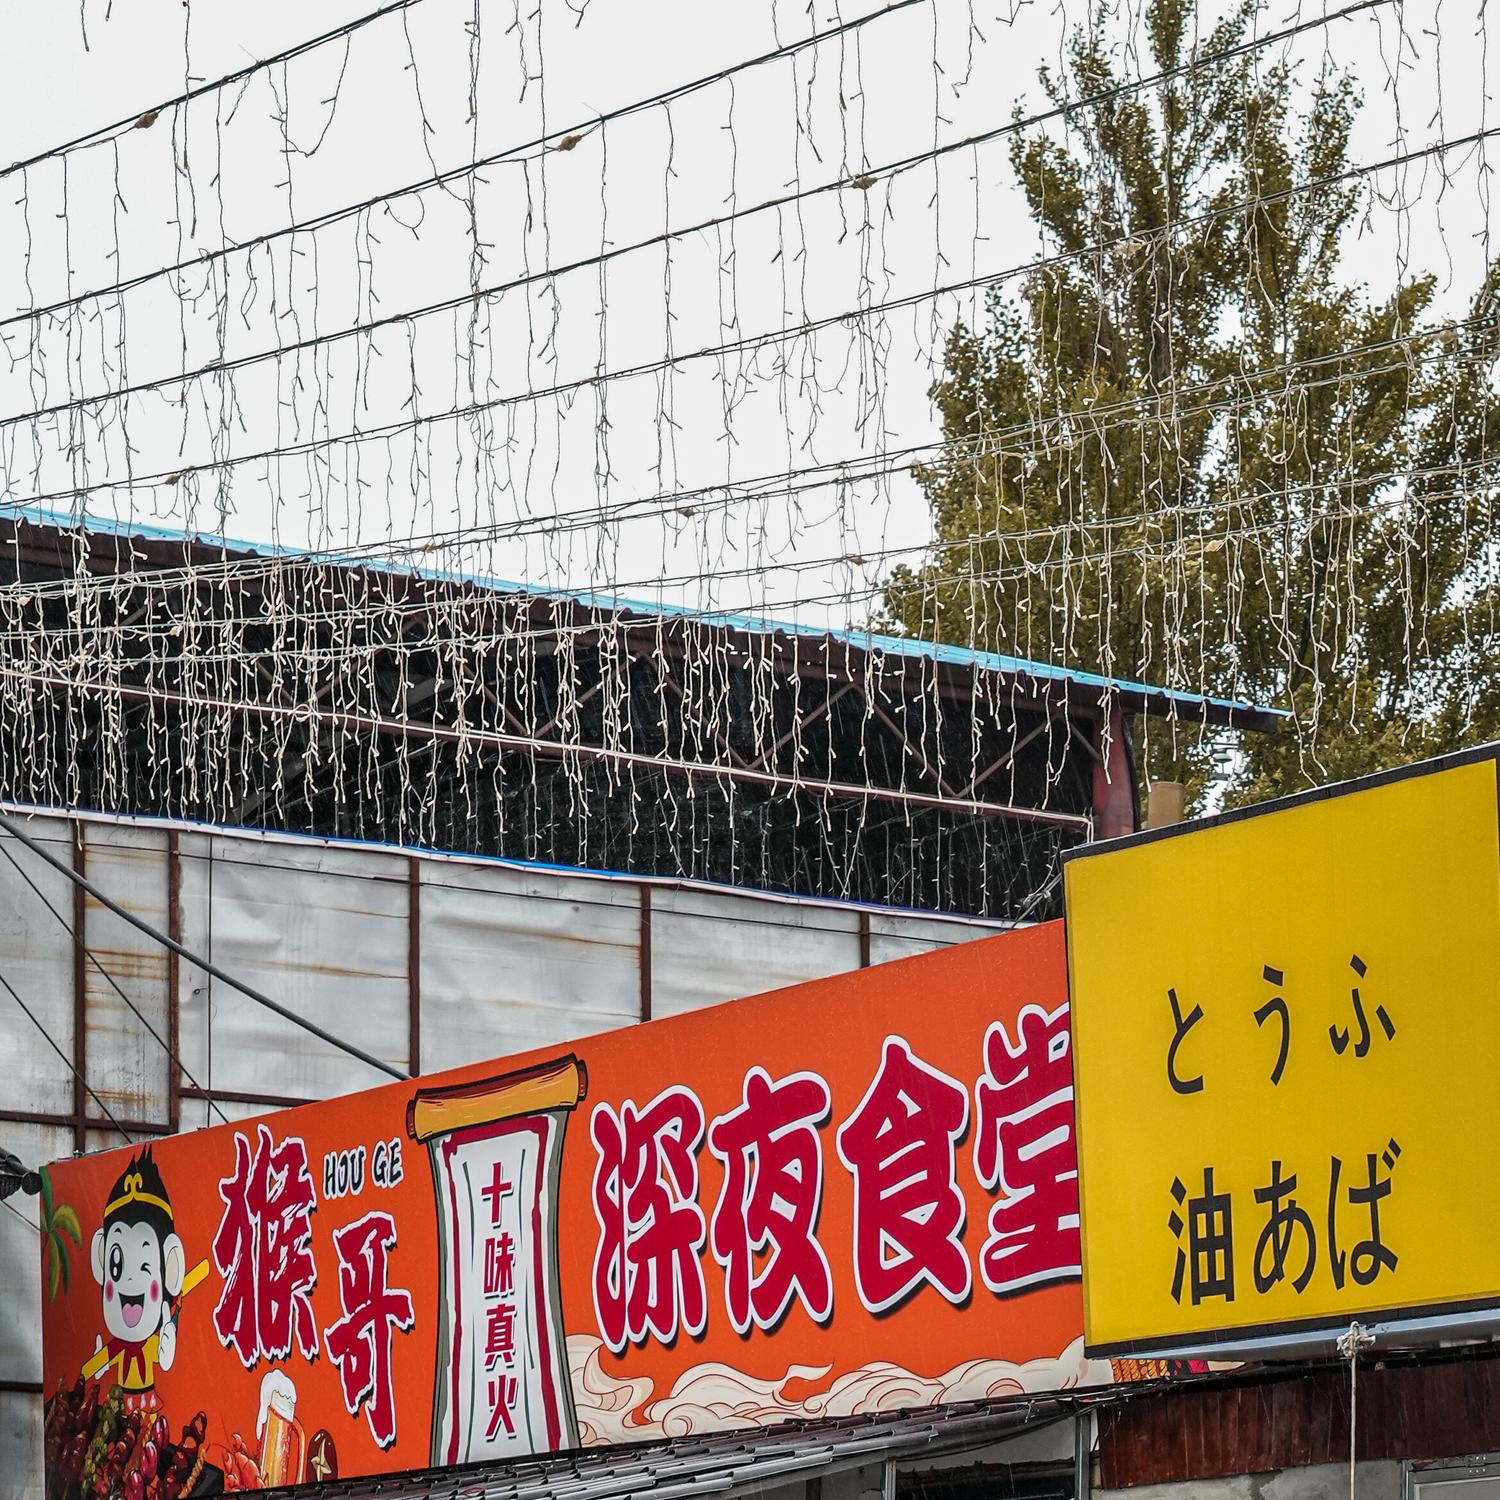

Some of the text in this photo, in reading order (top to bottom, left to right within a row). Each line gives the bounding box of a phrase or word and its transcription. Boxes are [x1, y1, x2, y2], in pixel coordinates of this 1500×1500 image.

[1166, 954, 1397, 1095] とうふ
[324, 1137, 404, 1198] HOU GE
[590, 1001, 1082, 1353] 深夜食堂
[1167, 1138, 1402, 1306] 油あば
[212, 1123, 416, 1450] 猴哥
[480, 1160, 519, 1443] 十味真火
